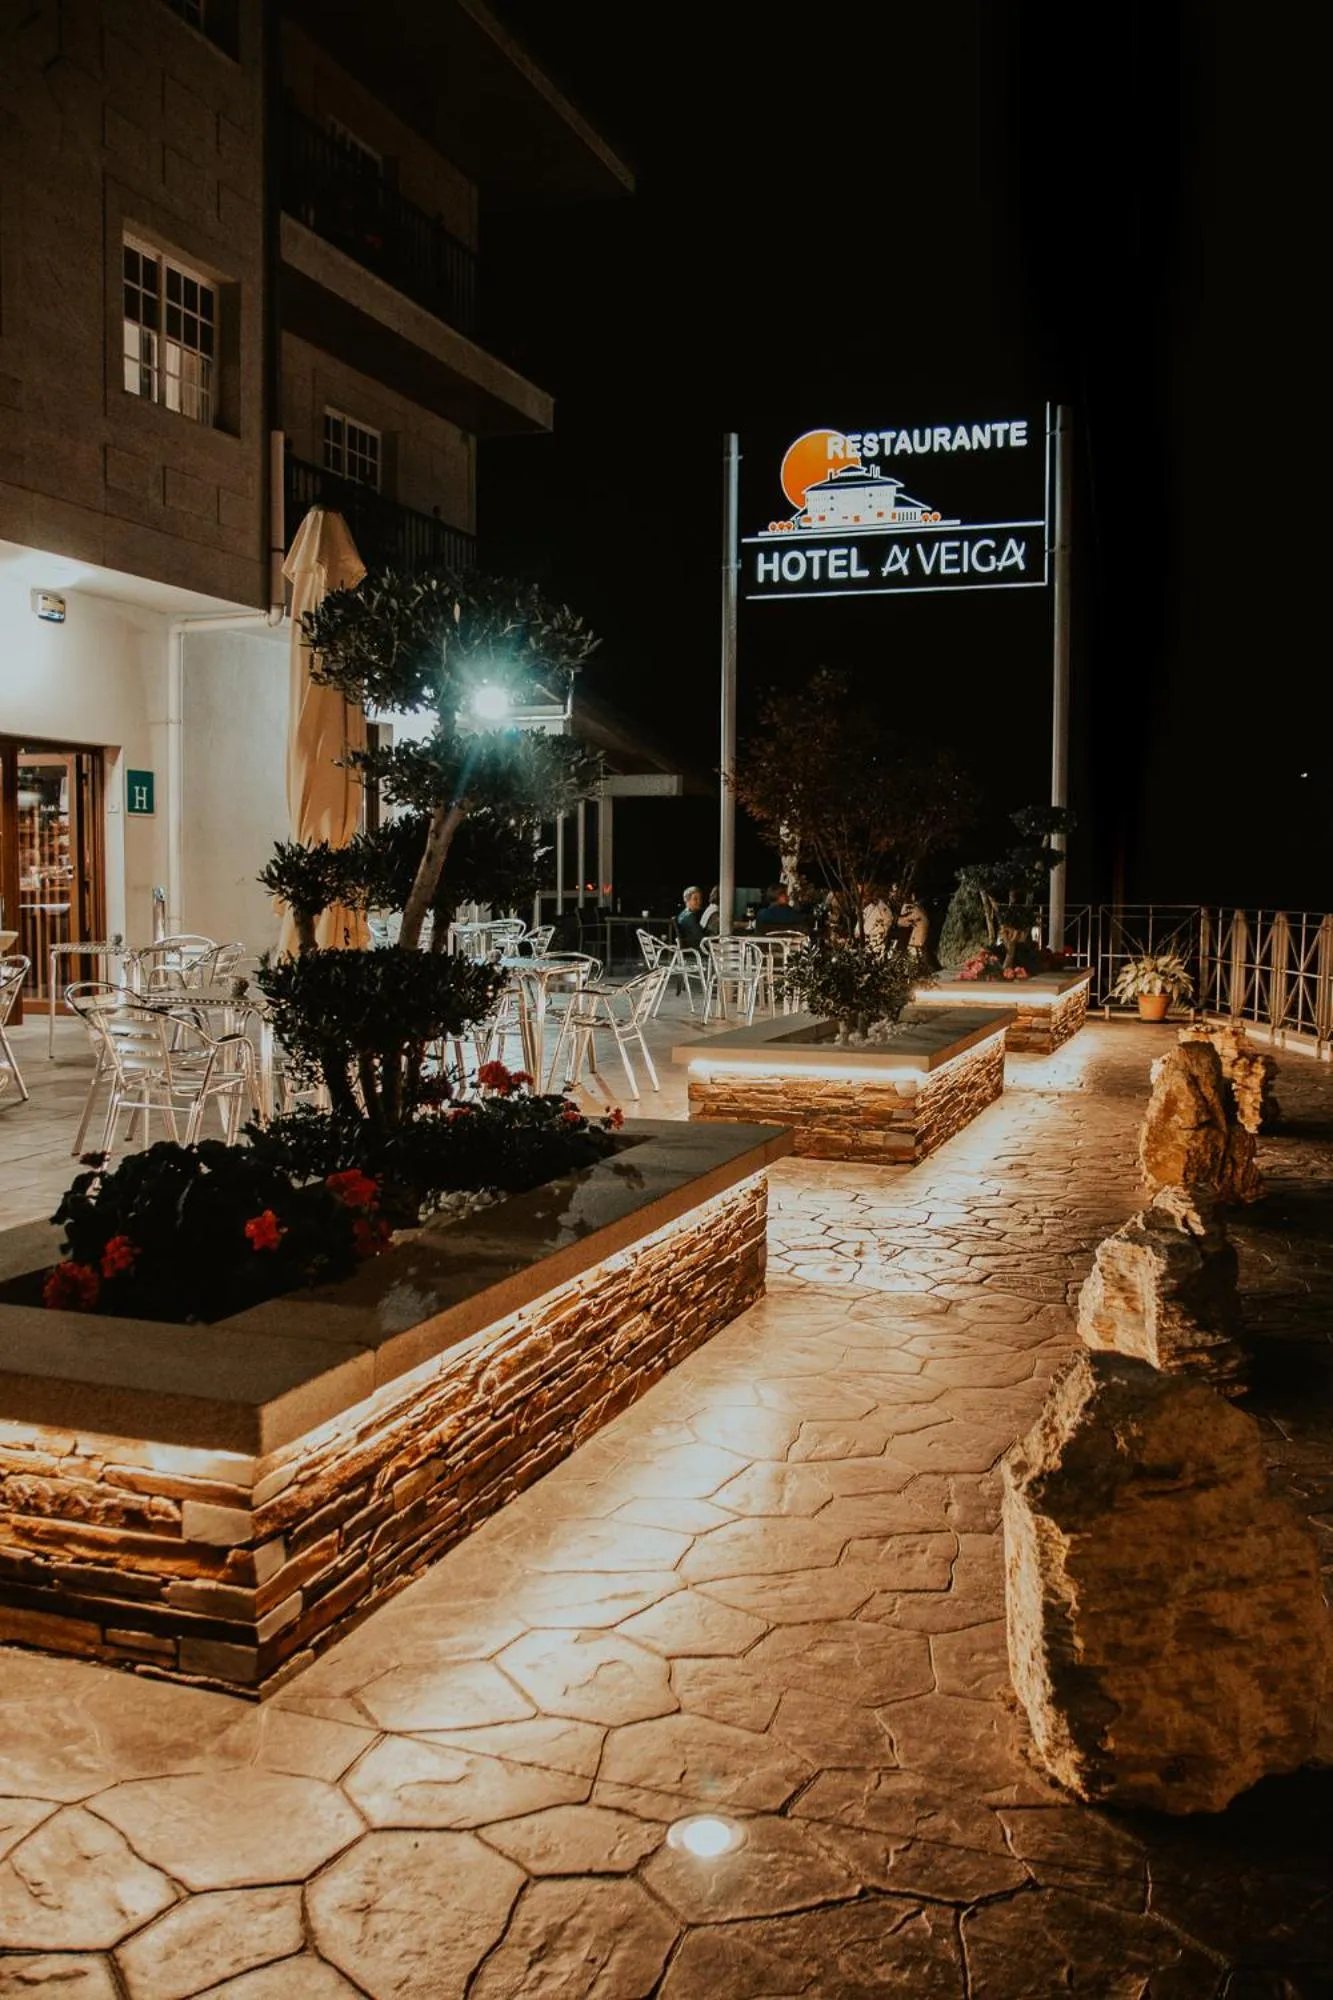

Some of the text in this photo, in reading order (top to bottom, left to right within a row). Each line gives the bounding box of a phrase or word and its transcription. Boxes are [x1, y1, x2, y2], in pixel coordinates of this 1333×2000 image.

[827, 421, 1028, 460] RESTAURANTE
[757, 538, 1026, 583] HOTEL A VEIGA
[134, 786, 148, 810] H
